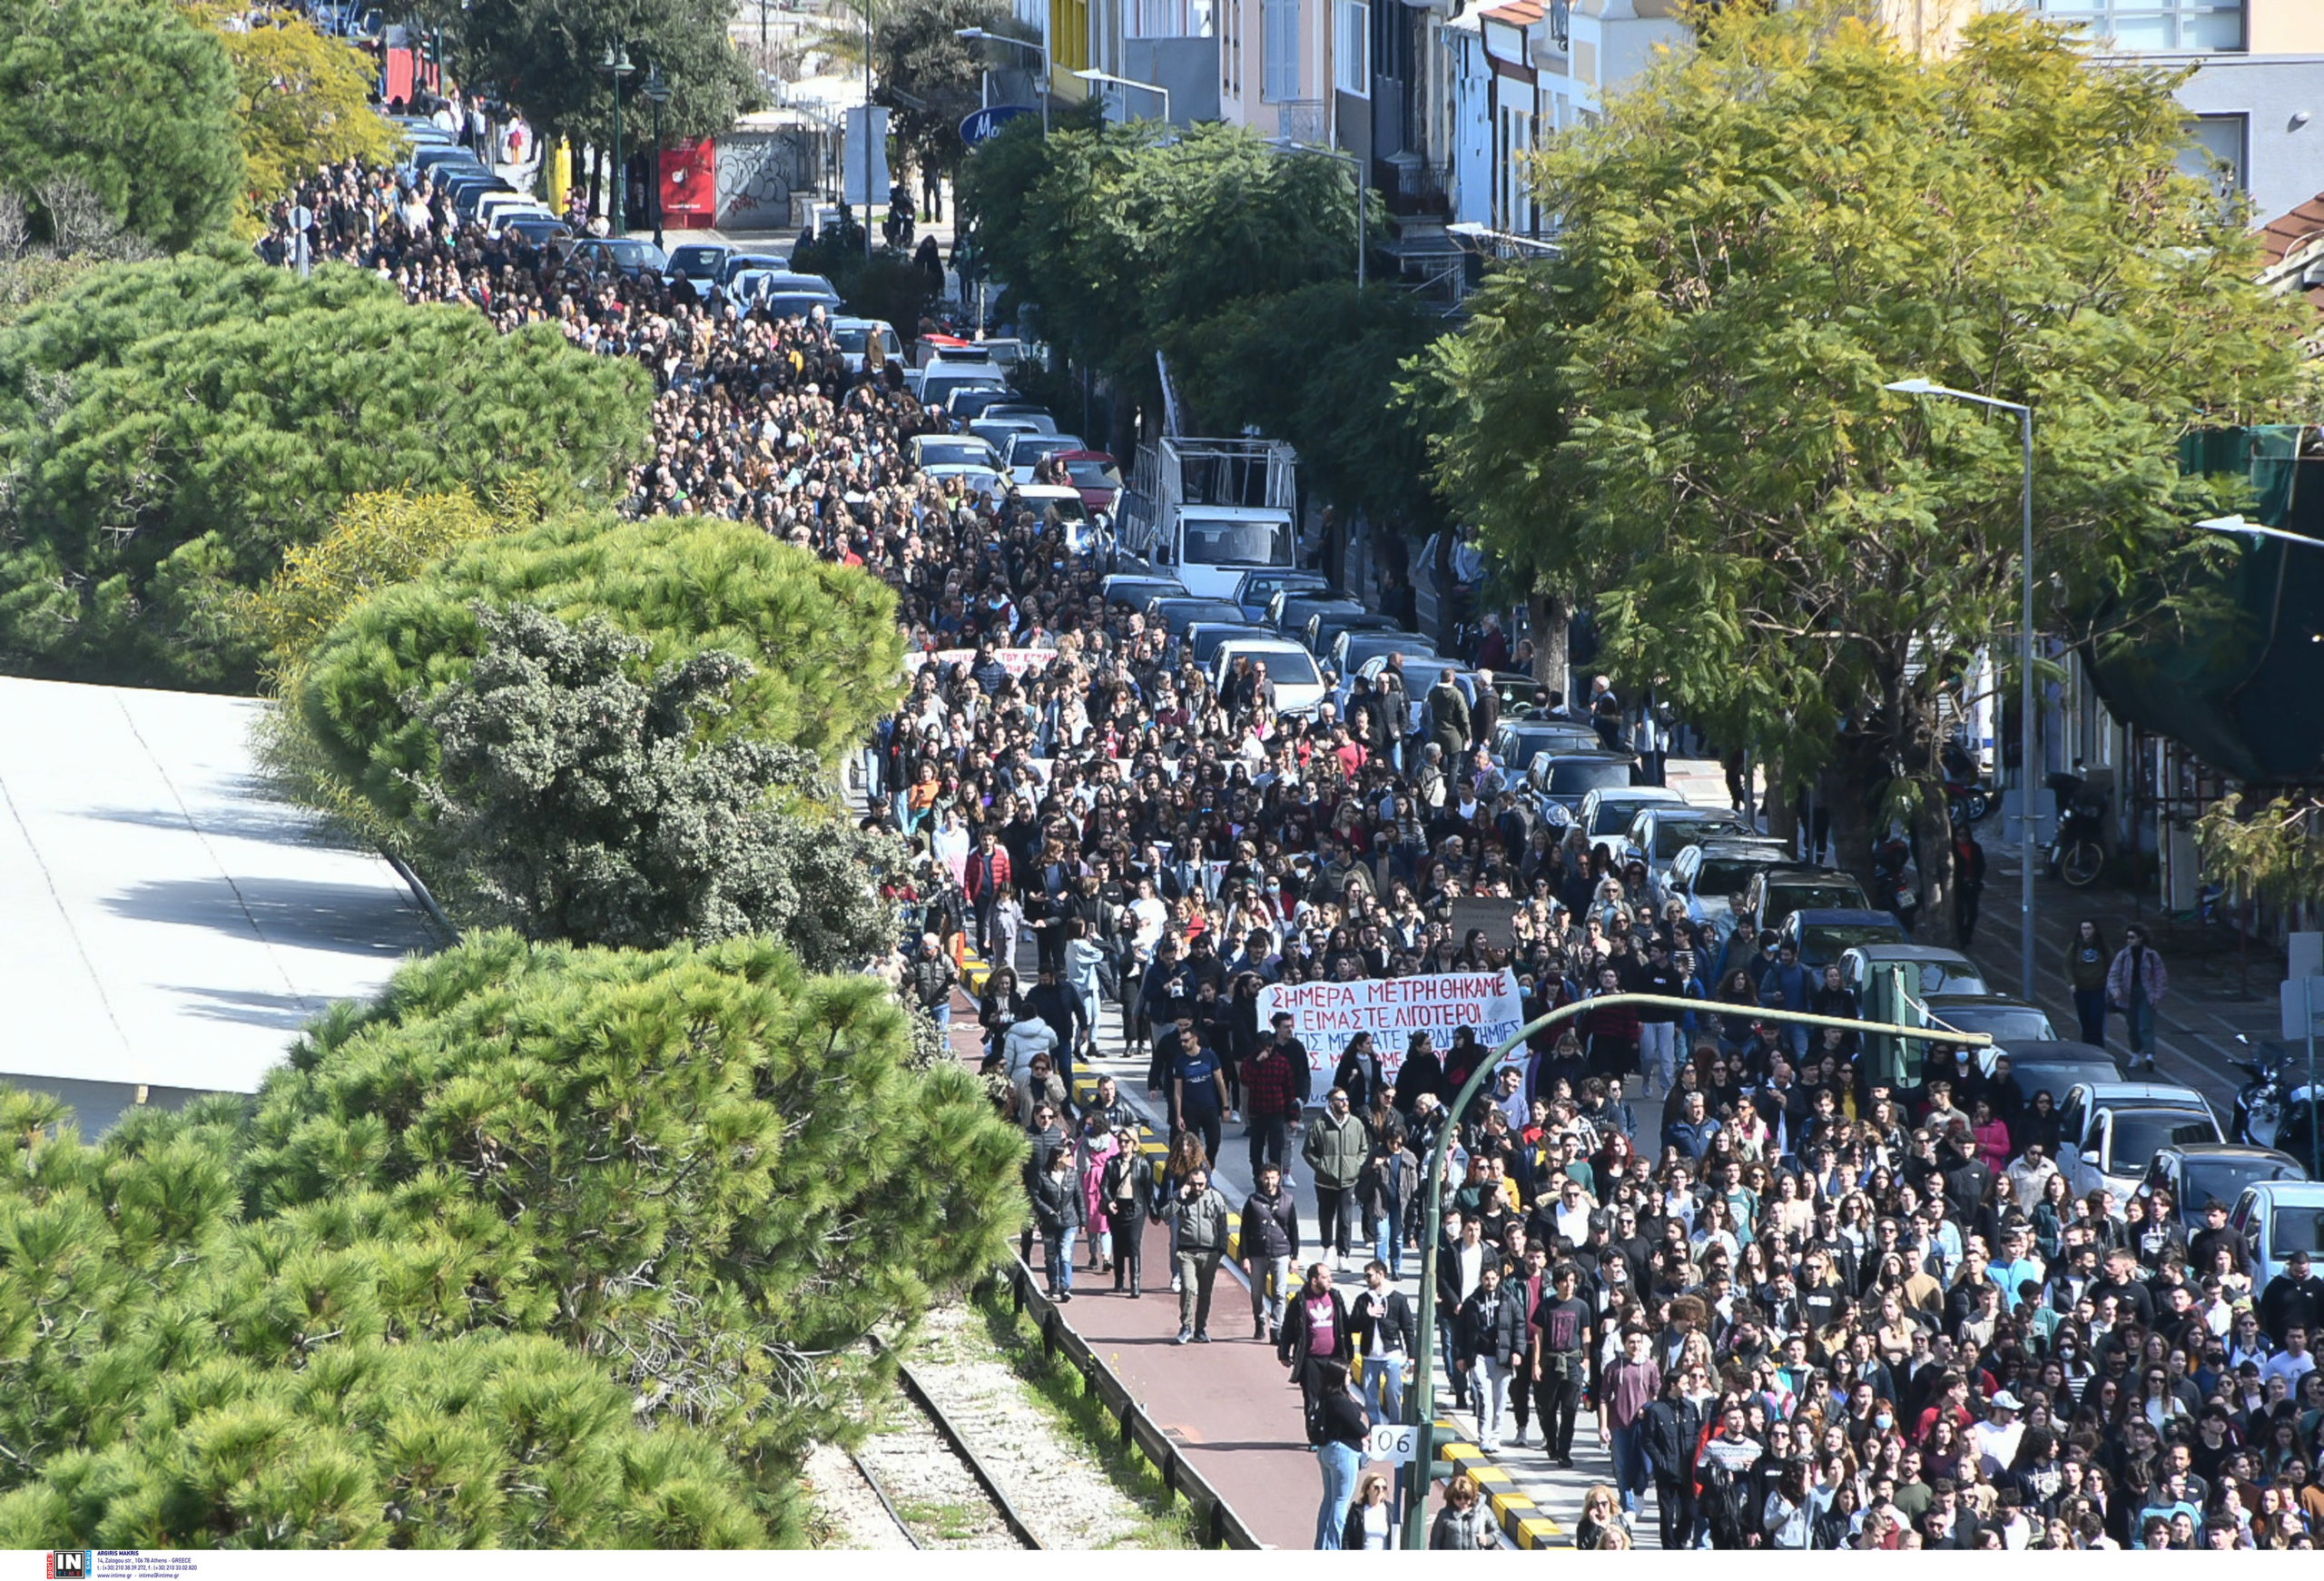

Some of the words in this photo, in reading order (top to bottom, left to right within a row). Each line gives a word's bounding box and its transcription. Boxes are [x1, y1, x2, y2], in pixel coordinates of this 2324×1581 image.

[1272, 986, 1355, 1008] ΣΗΜΕΡΑ
[1368, 973, 1508, 1003] ΜΕΤΡΗΘΗΚΑΜΕ
[1304, 1007, 1391, 1031] ΕΙΜΑΣΤΕ
